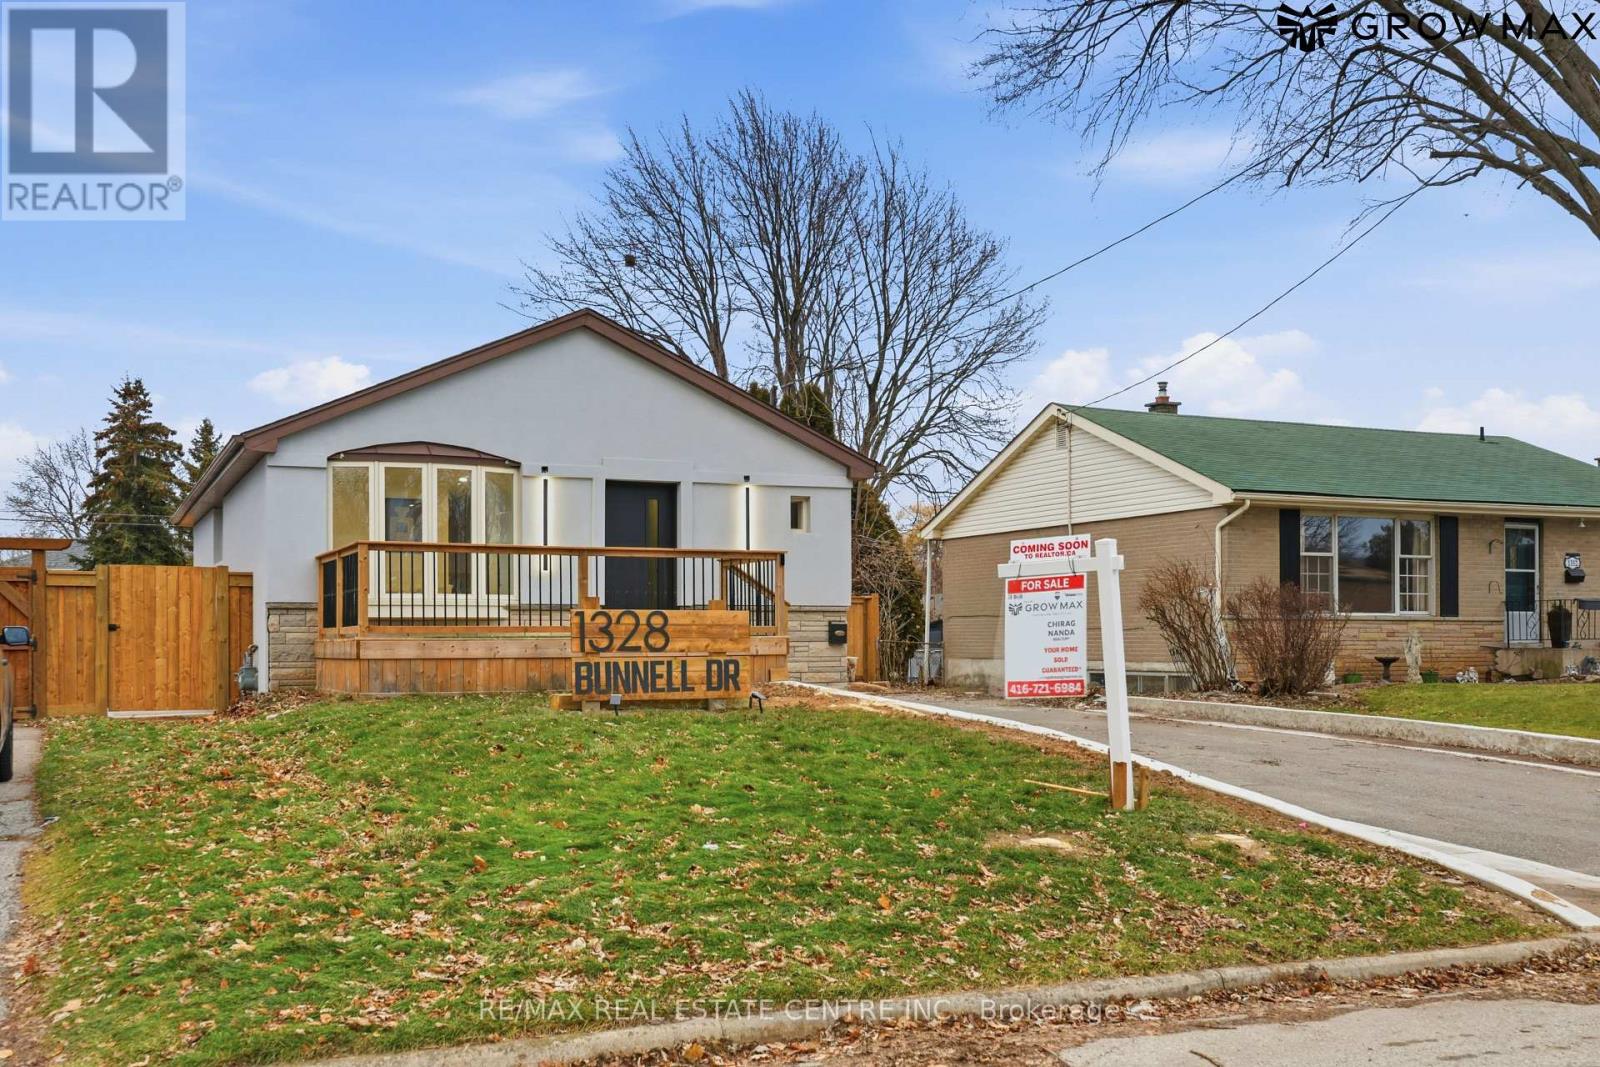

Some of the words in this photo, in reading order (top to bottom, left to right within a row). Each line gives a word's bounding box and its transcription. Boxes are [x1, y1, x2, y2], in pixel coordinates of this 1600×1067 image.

[1013, 543, 1054, 554] COMING
[1058, 540, 1088, 550] SOON
[1035, 550, 1076, 558] REALTOR.CA
[1021, 580, 1041, 591] FOR
[1044, 578, 1070, 589] SALE
[1047, 620, 1076, 628] CHIRAG
[574, 610, 670, 653] 1328
[1048, 629, 1075, 637] NANDA
[574, 660, 695, 695] BUNNELL
[706, 659, 741, 692] DR
